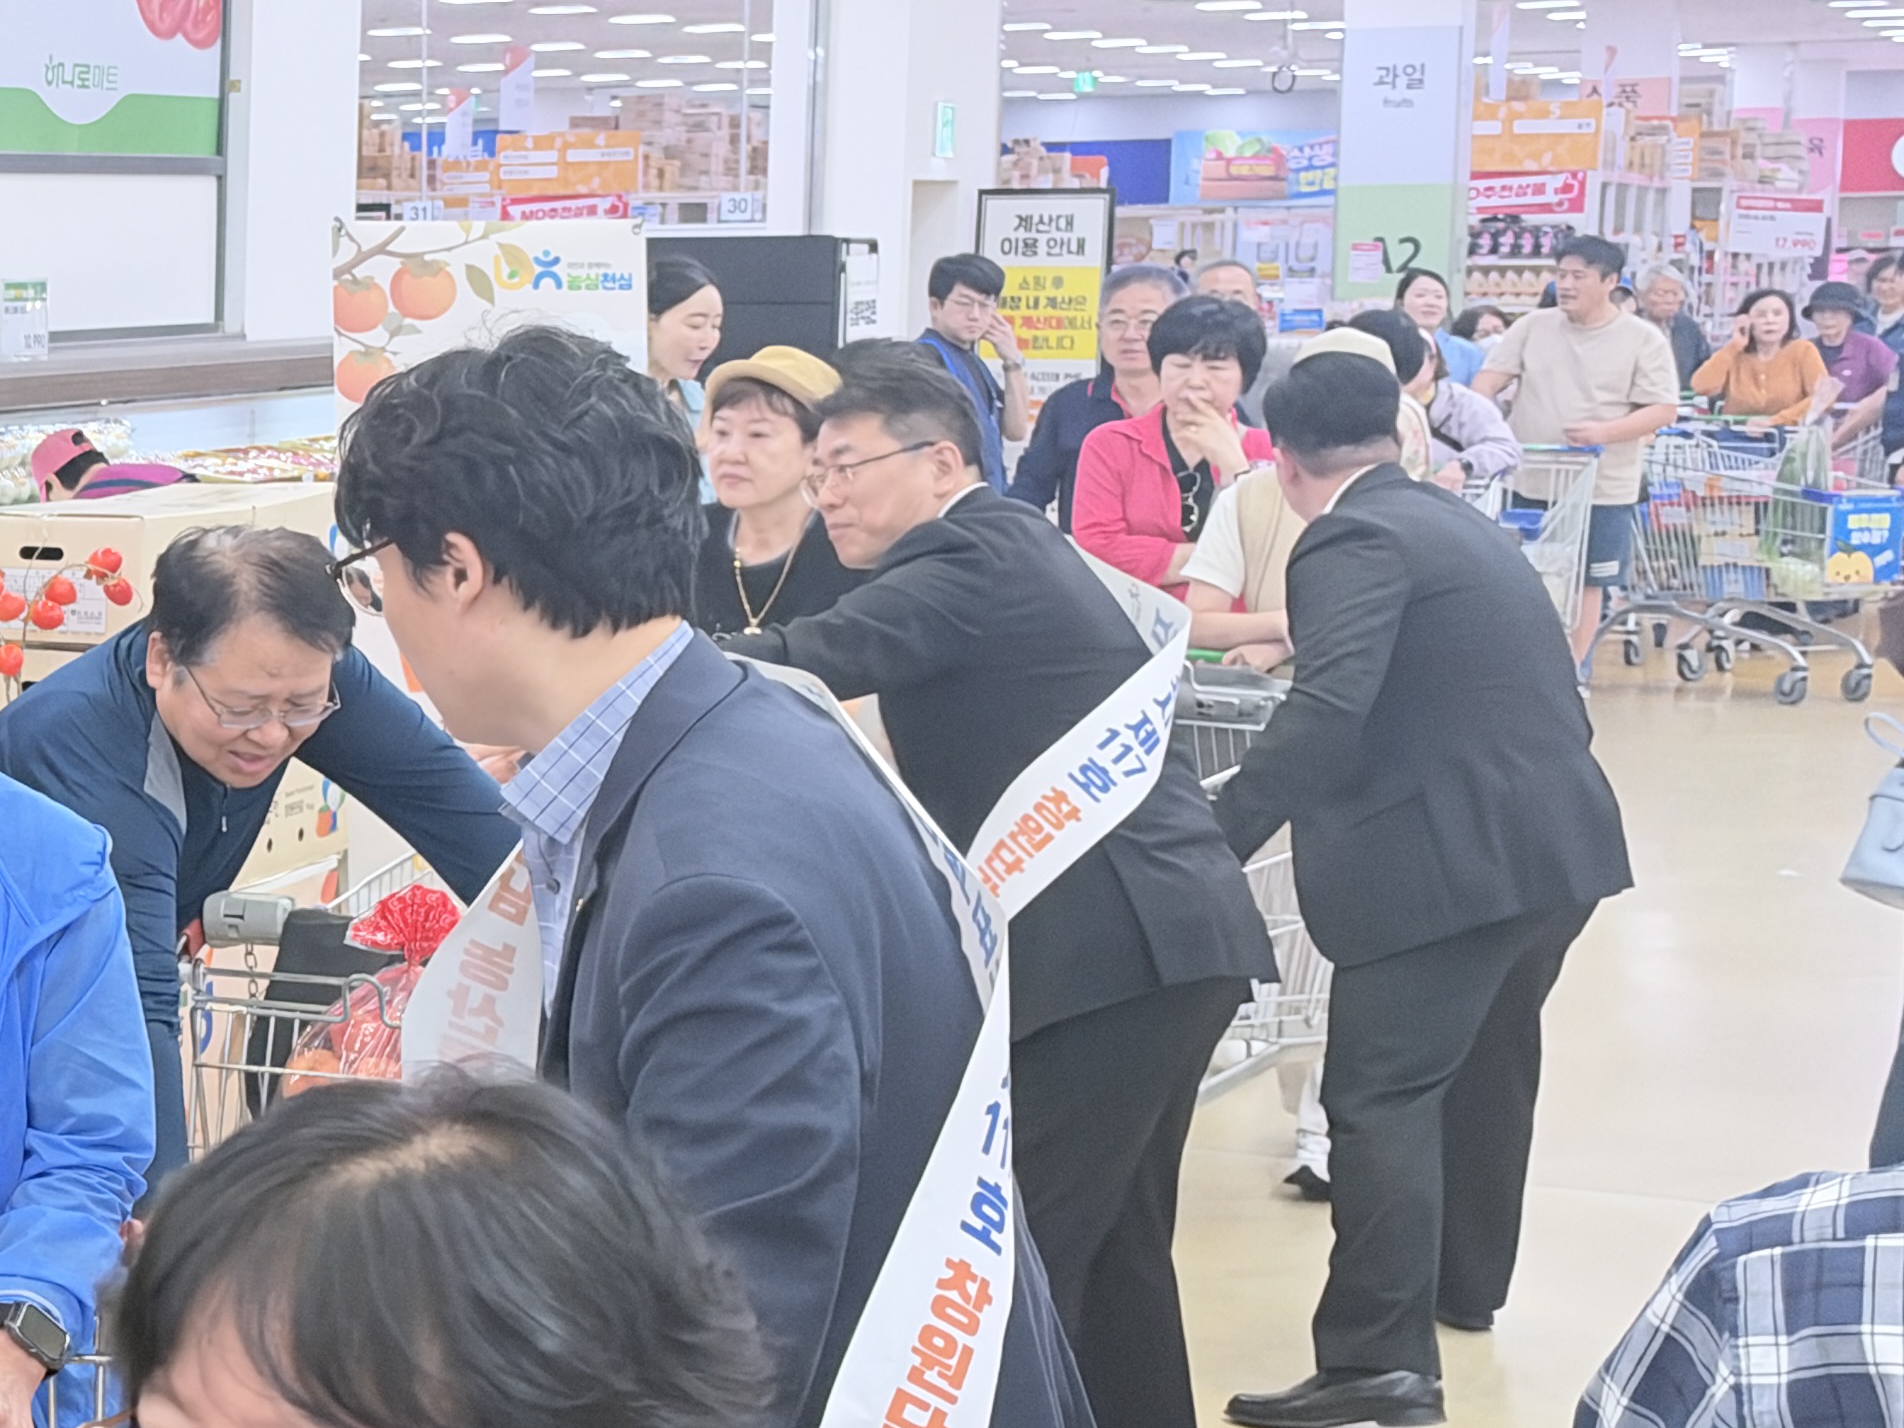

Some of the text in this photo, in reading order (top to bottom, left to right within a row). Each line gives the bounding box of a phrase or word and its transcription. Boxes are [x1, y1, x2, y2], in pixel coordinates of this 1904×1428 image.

[44, 52, 119, 92] 하나로마트
[1372, 63, 1426, 91] 과일
[727, 197, 749, 215] 30
[1013, 213, 1075, 234] 계산대
[1000, 236, 1086, 257] 이용 안내
[566, 272, 633, 291] 농심천심
